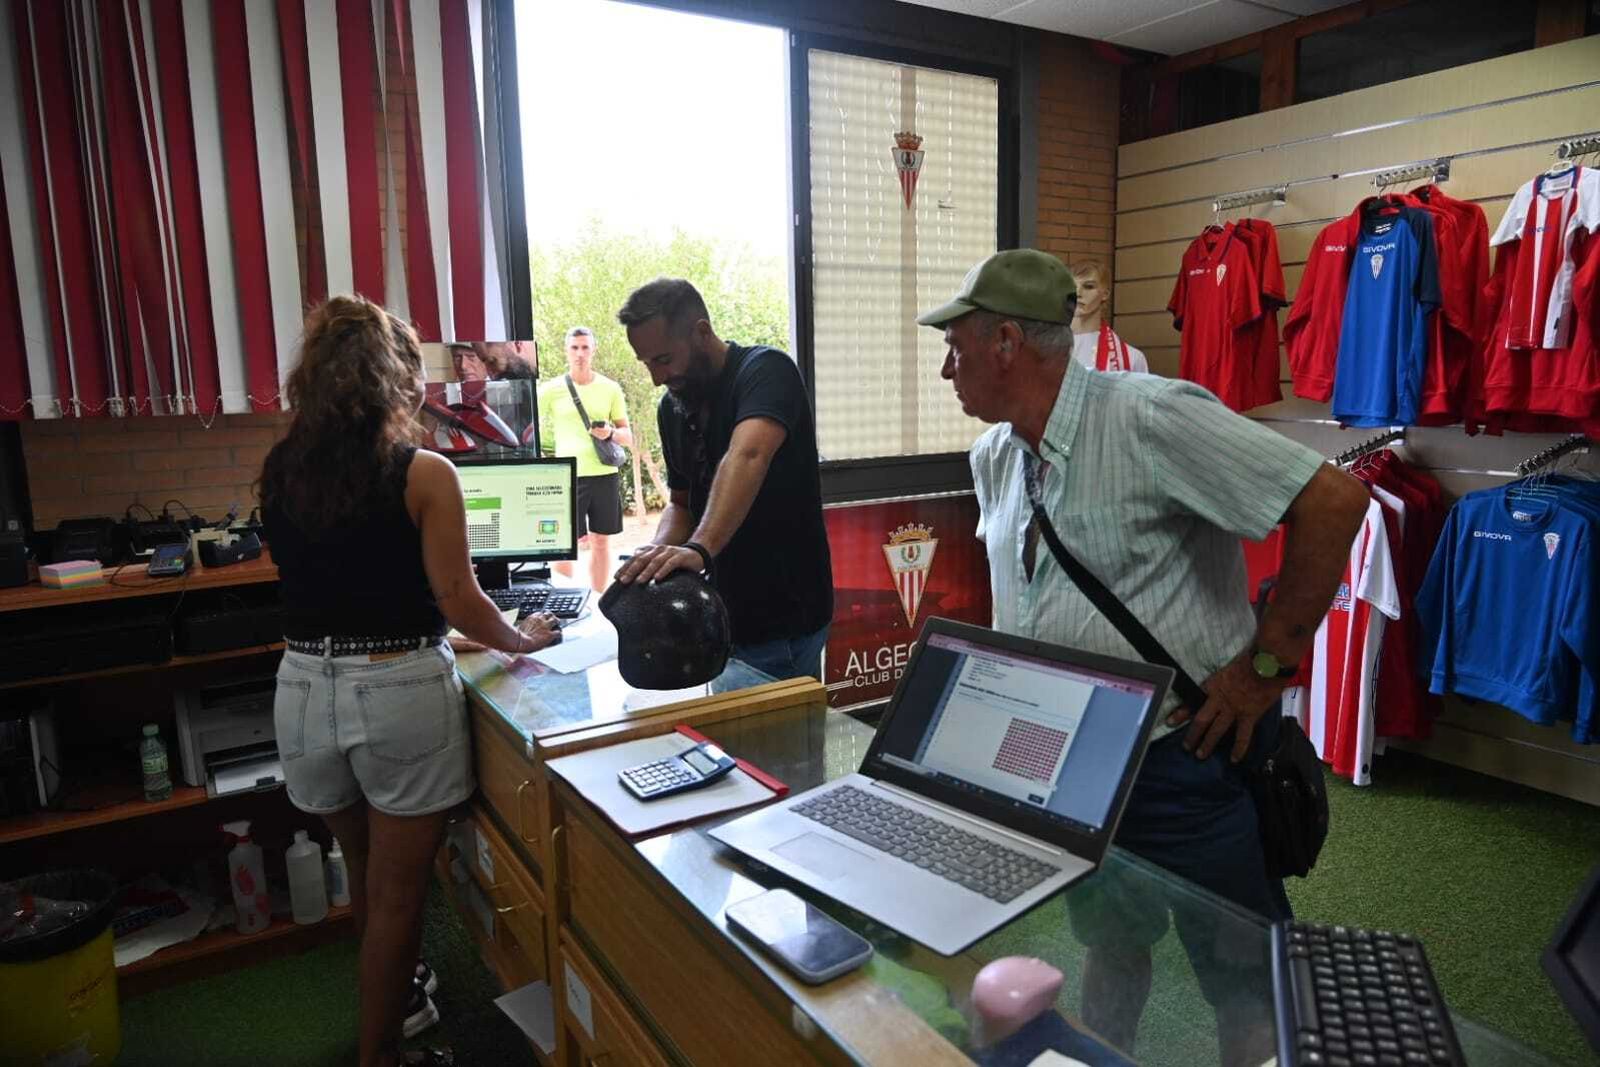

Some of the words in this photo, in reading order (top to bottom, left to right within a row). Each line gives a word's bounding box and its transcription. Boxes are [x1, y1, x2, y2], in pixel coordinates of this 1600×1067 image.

[1473, 531, 1512, 541] GIVOVA
[854, 671, 890, 687] CLUB
[894, 668, 904, 680] D
